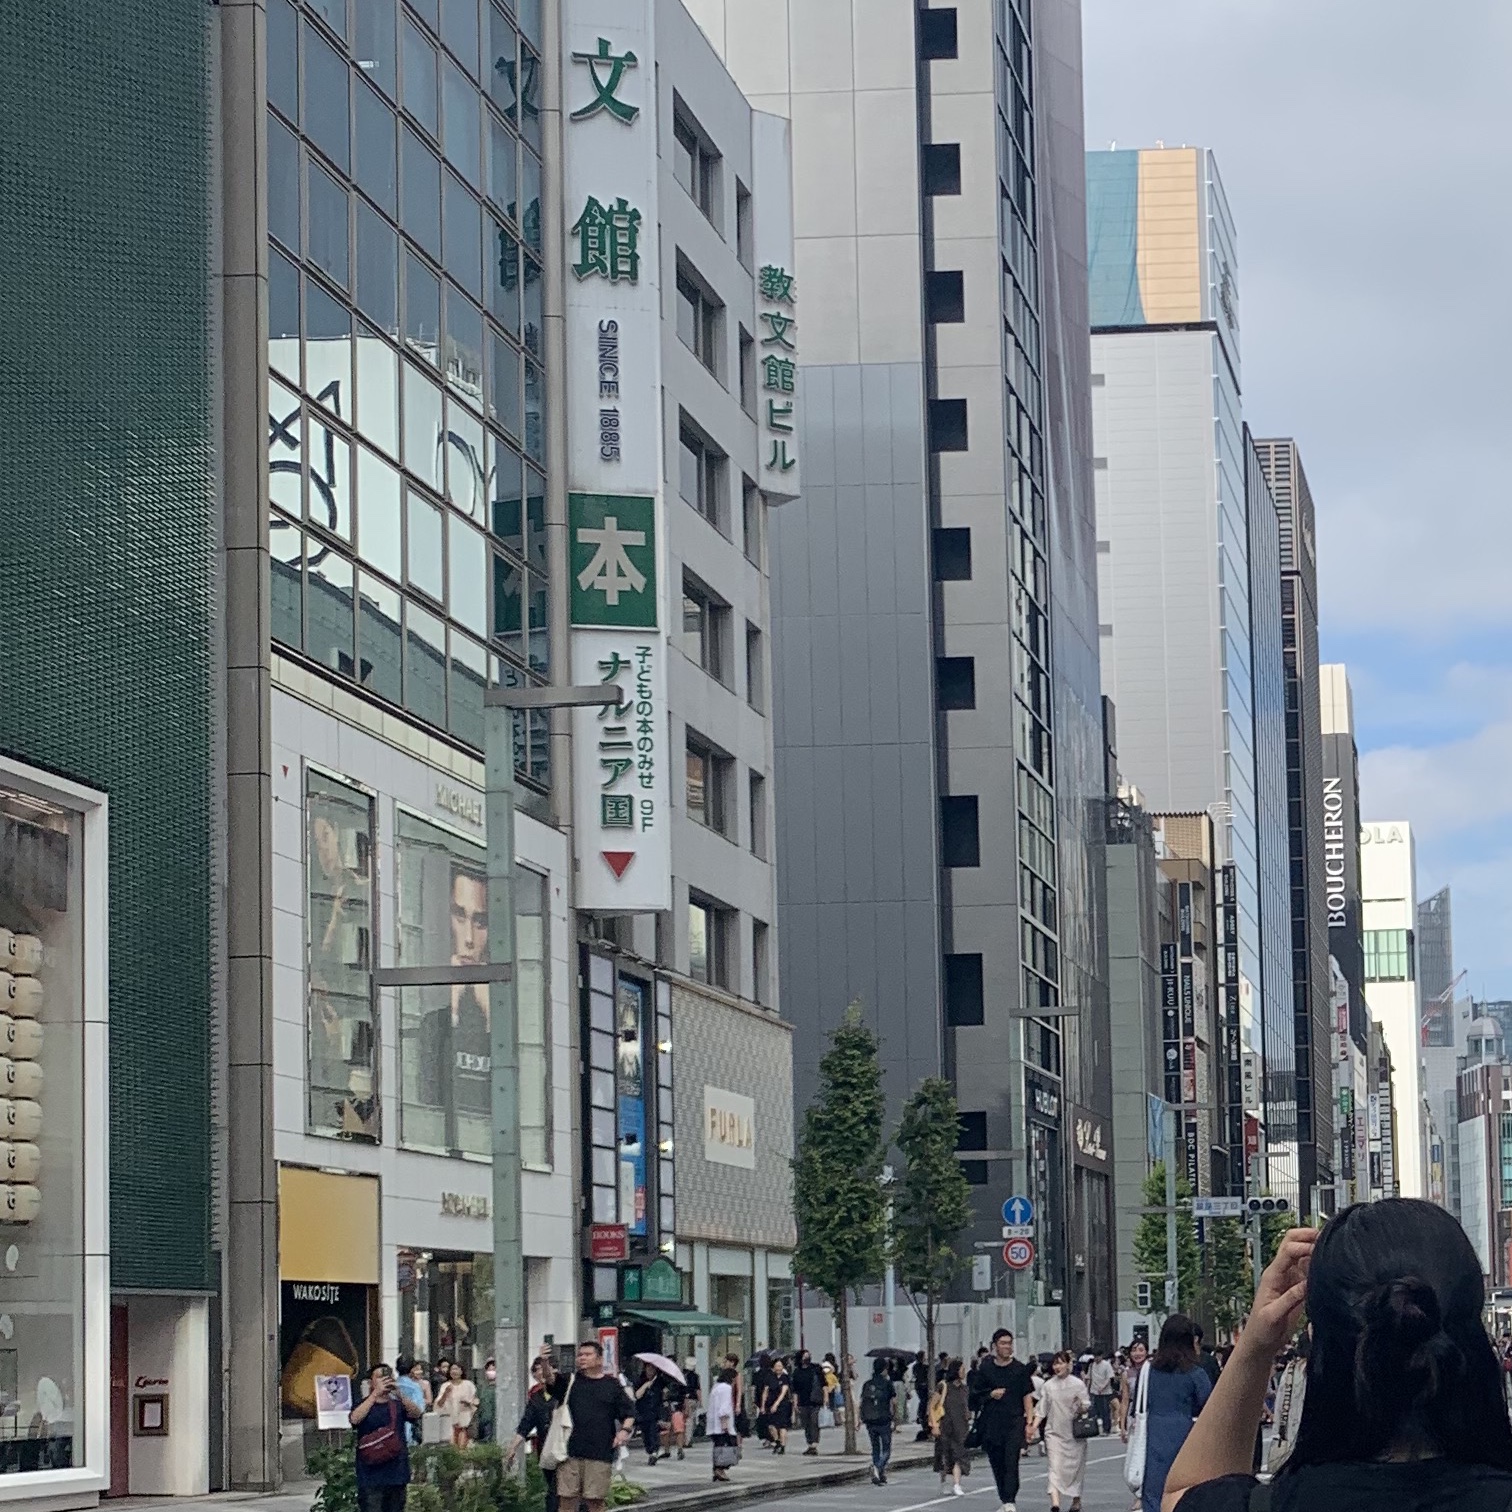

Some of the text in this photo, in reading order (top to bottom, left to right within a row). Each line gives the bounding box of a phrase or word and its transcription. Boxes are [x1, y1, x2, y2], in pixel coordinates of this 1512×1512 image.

[570, 37, 641, 284] 文館
[598, 318, 621, 462] SINCE 1885
[758, 264, 795, 471] 教文館ビル
[575, 515, 649, 607] 本
[597, 651, 635, 829] ナルニア国
[634, 645, 655, 789] 子どもの本のみせ
[1323, 777, 1347, 928] BOUCHERON
[708, 1107, 752, 1149] FURLA
[1010, 1246, 1027, 1260] 50
